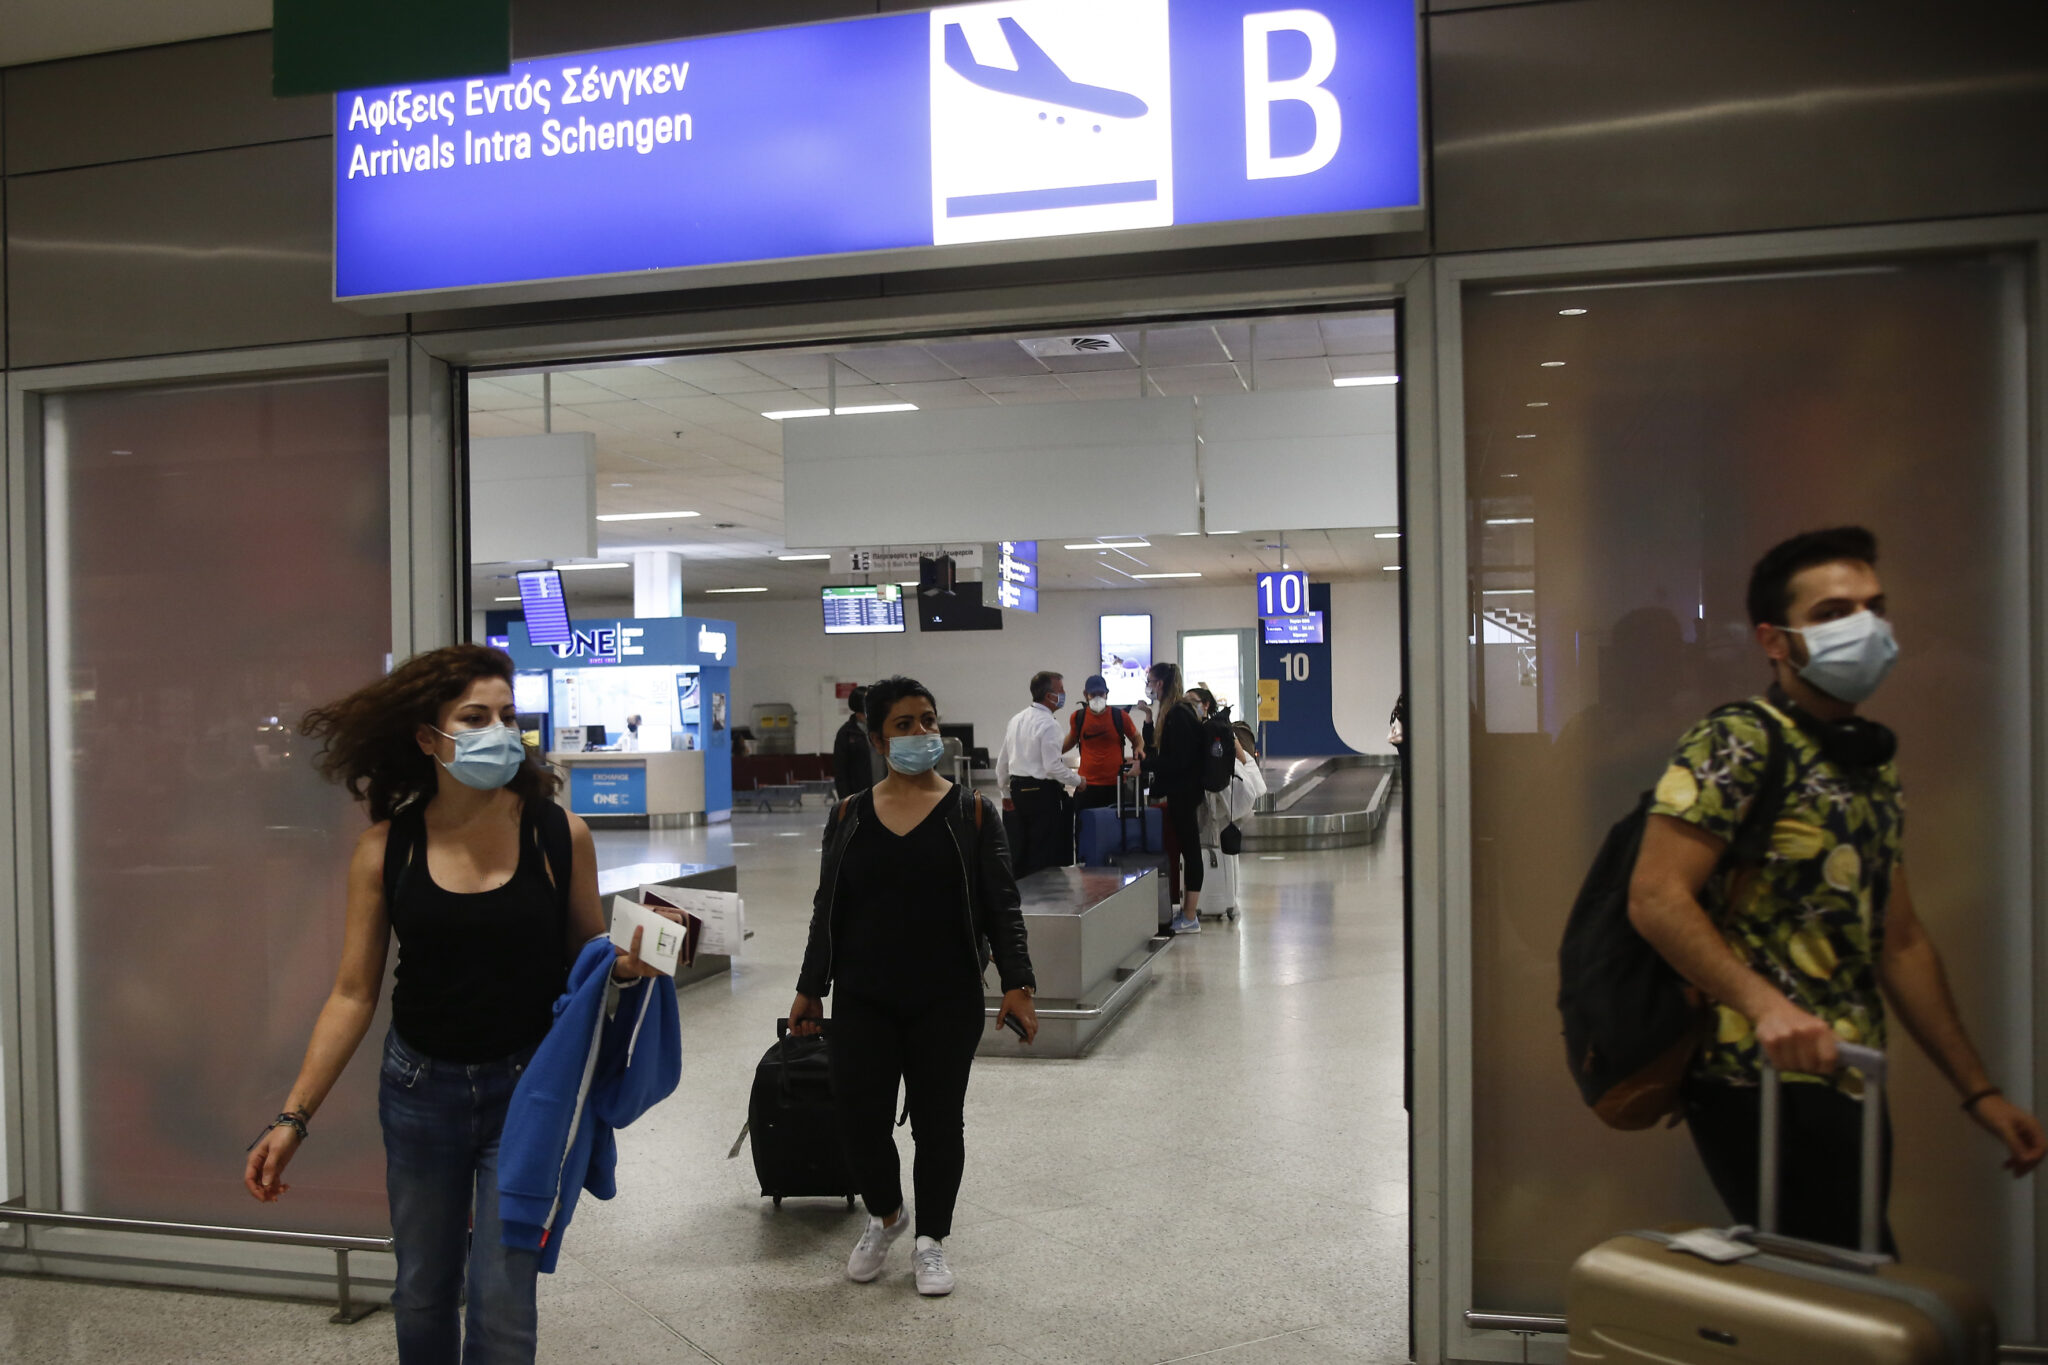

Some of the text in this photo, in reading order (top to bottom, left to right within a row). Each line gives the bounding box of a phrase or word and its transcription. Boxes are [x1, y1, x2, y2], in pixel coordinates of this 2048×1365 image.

[348, 62, 690, 135] Αφίξεις Εντός Σένγκεν
[1242, 9, 1342, 180] B
[348, 113, 693, 179] Arrivals Intra Schengen
[1260, 573, 1301, 614] 10
[1280, 653, 1310, 681] 10
